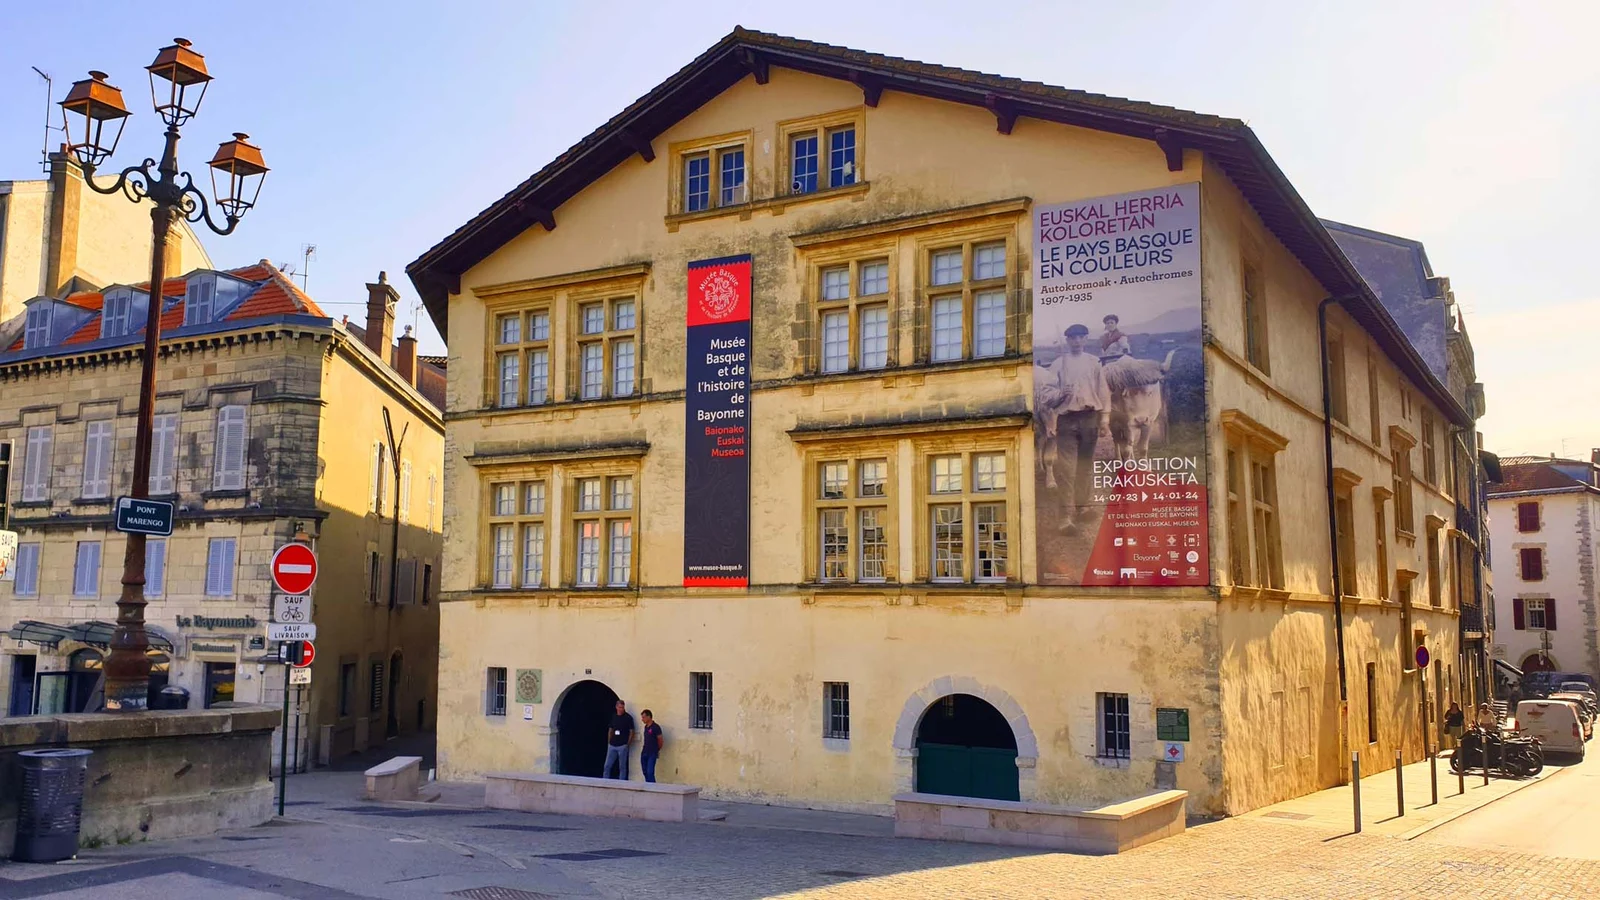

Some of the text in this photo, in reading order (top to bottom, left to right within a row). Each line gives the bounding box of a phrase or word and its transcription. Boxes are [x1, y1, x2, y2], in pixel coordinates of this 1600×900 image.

[1040, 192, 1184, 228] EUSKAL HERRIA
[1040, 213, 1155, 243] KOLORETAN
[1041, 228, 1193, 263] LE PAYS BASQUE
[1041, 248, 1173, 279] EN COULEURS
[719, 269, 739, 287] Basque
[1040, 269, 1193, 295] Autokromoak Autochromes
[1040, 292, 1093, 305] 1907-1935
[710, 336, 746, 350] Musée
[706, 352, 746, 366] Basque
[717, 364, 745, 377] et de
[697, 379, 745, 393] l'histoire
[730, 392, 745, 404] de
[697, 408, 745, 423] Bayonne
[705, 425, 745, 436] Baionako
[717, 435, 745, 446] Euskal
[711, 447, 745, 457] Museoa
[1093, 456, 1197, 474] EXPOSITION
[1093, 472, 1199, 489] ERAKUSKETA
[136, 505, 156, 514] PONT
[1169, 510, 1199, 518] BAYONNE
[1173, 505, 1198, 513] BASQUE
[126, 516, 164, 527] MARENGO
[1173, 519, 1200, 527] MUSEOA
[284, 596, 304, 604] SAUF
[193, 614, 257, 631] Bayonnais
